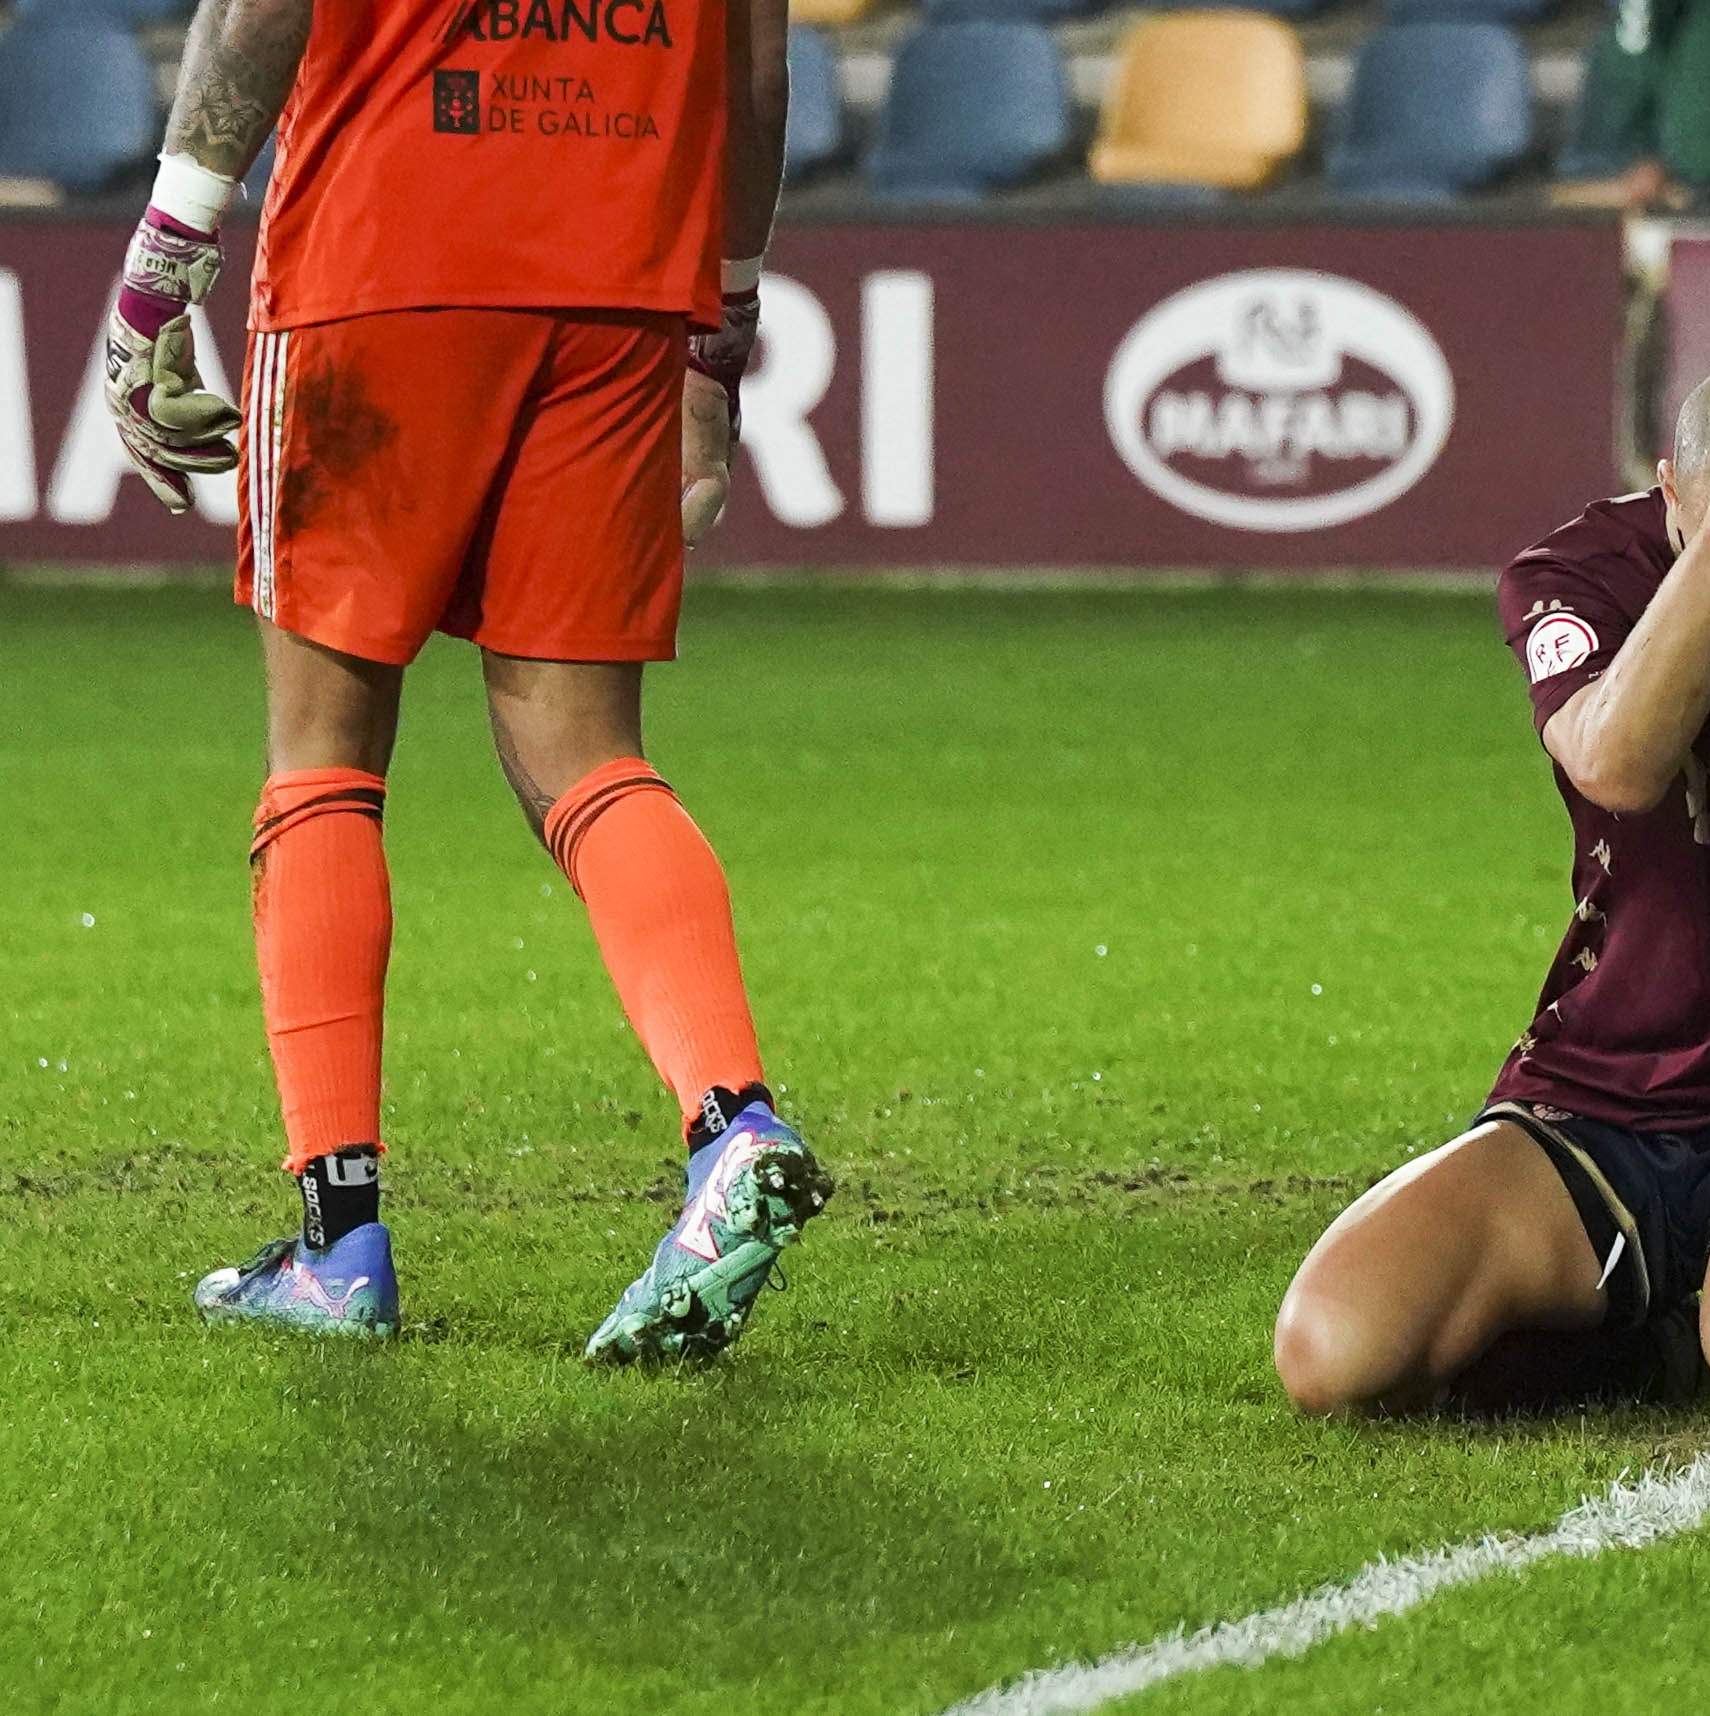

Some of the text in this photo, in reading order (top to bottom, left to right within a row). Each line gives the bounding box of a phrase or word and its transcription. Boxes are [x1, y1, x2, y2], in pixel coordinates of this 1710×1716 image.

[490, 74, 595, 104] XUNTA
[489, 105, 661, 140] DE GALICIA
[702, 1089, 729, 1134] OCKS
[302, 1173, 326, 1247] SOCKS
